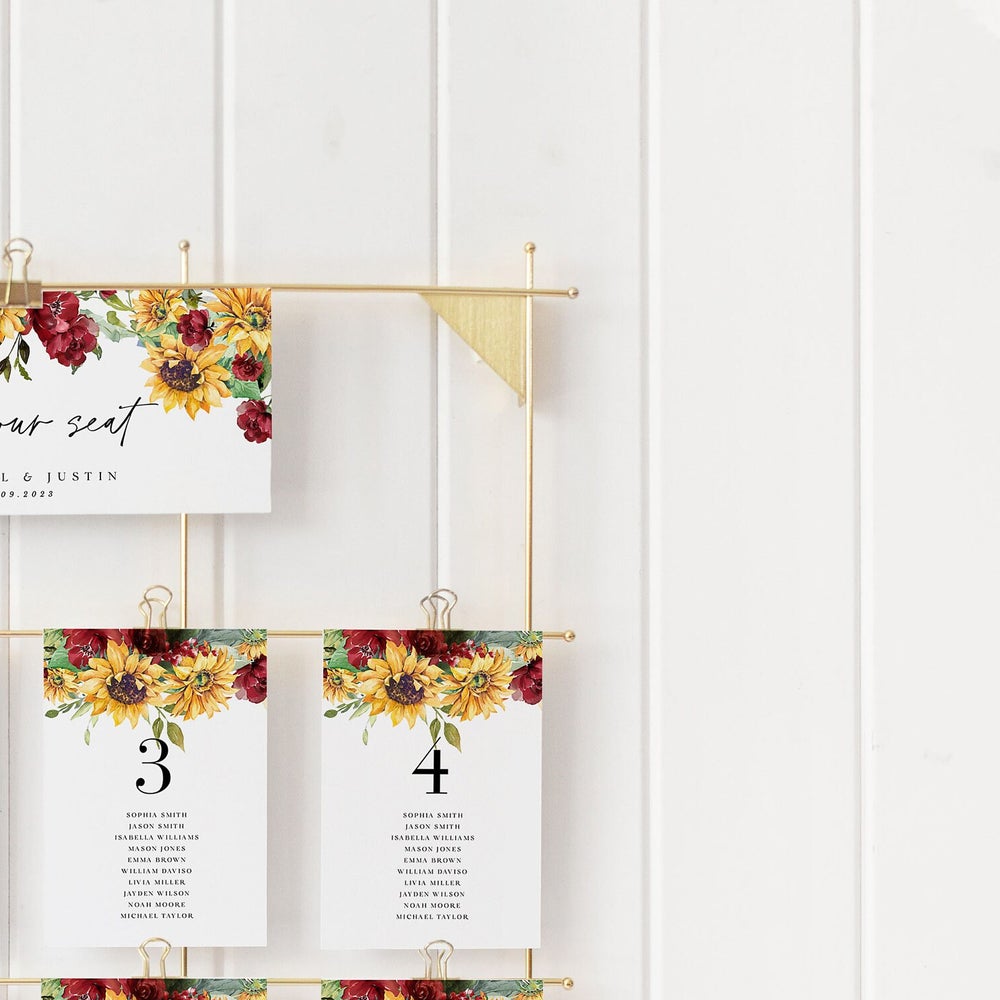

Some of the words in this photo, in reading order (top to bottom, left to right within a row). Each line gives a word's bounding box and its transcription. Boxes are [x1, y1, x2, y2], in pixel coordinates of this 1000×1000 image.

[67, 396, 159, 447] seat
[23, 472, 32, 482] &
[47, 471, 118, 484] JUSTIN
[135, 738, 171, 795] 3
[411, 736, 449, 794] 4
[125, 811, 158, 819] SOPHIA
[160, 811, 188, 819] SMITH
[402, 811, 434, 819] SOPHIA
[405, 823, 431, 831] JASON
[404, 845, 434, 853] MASON
[435, 845, 462, 854] JONES
[127, 856, 152, 864] EMMA
[154, 856, 187, 864] BROWN
[437, 868, 468, 876] DAVISO
[399, 890, 430, 899] JAYDEN
[395, 913, 434, 921] MICHAEL
[436, 913, 469, 921] TAYLOR
